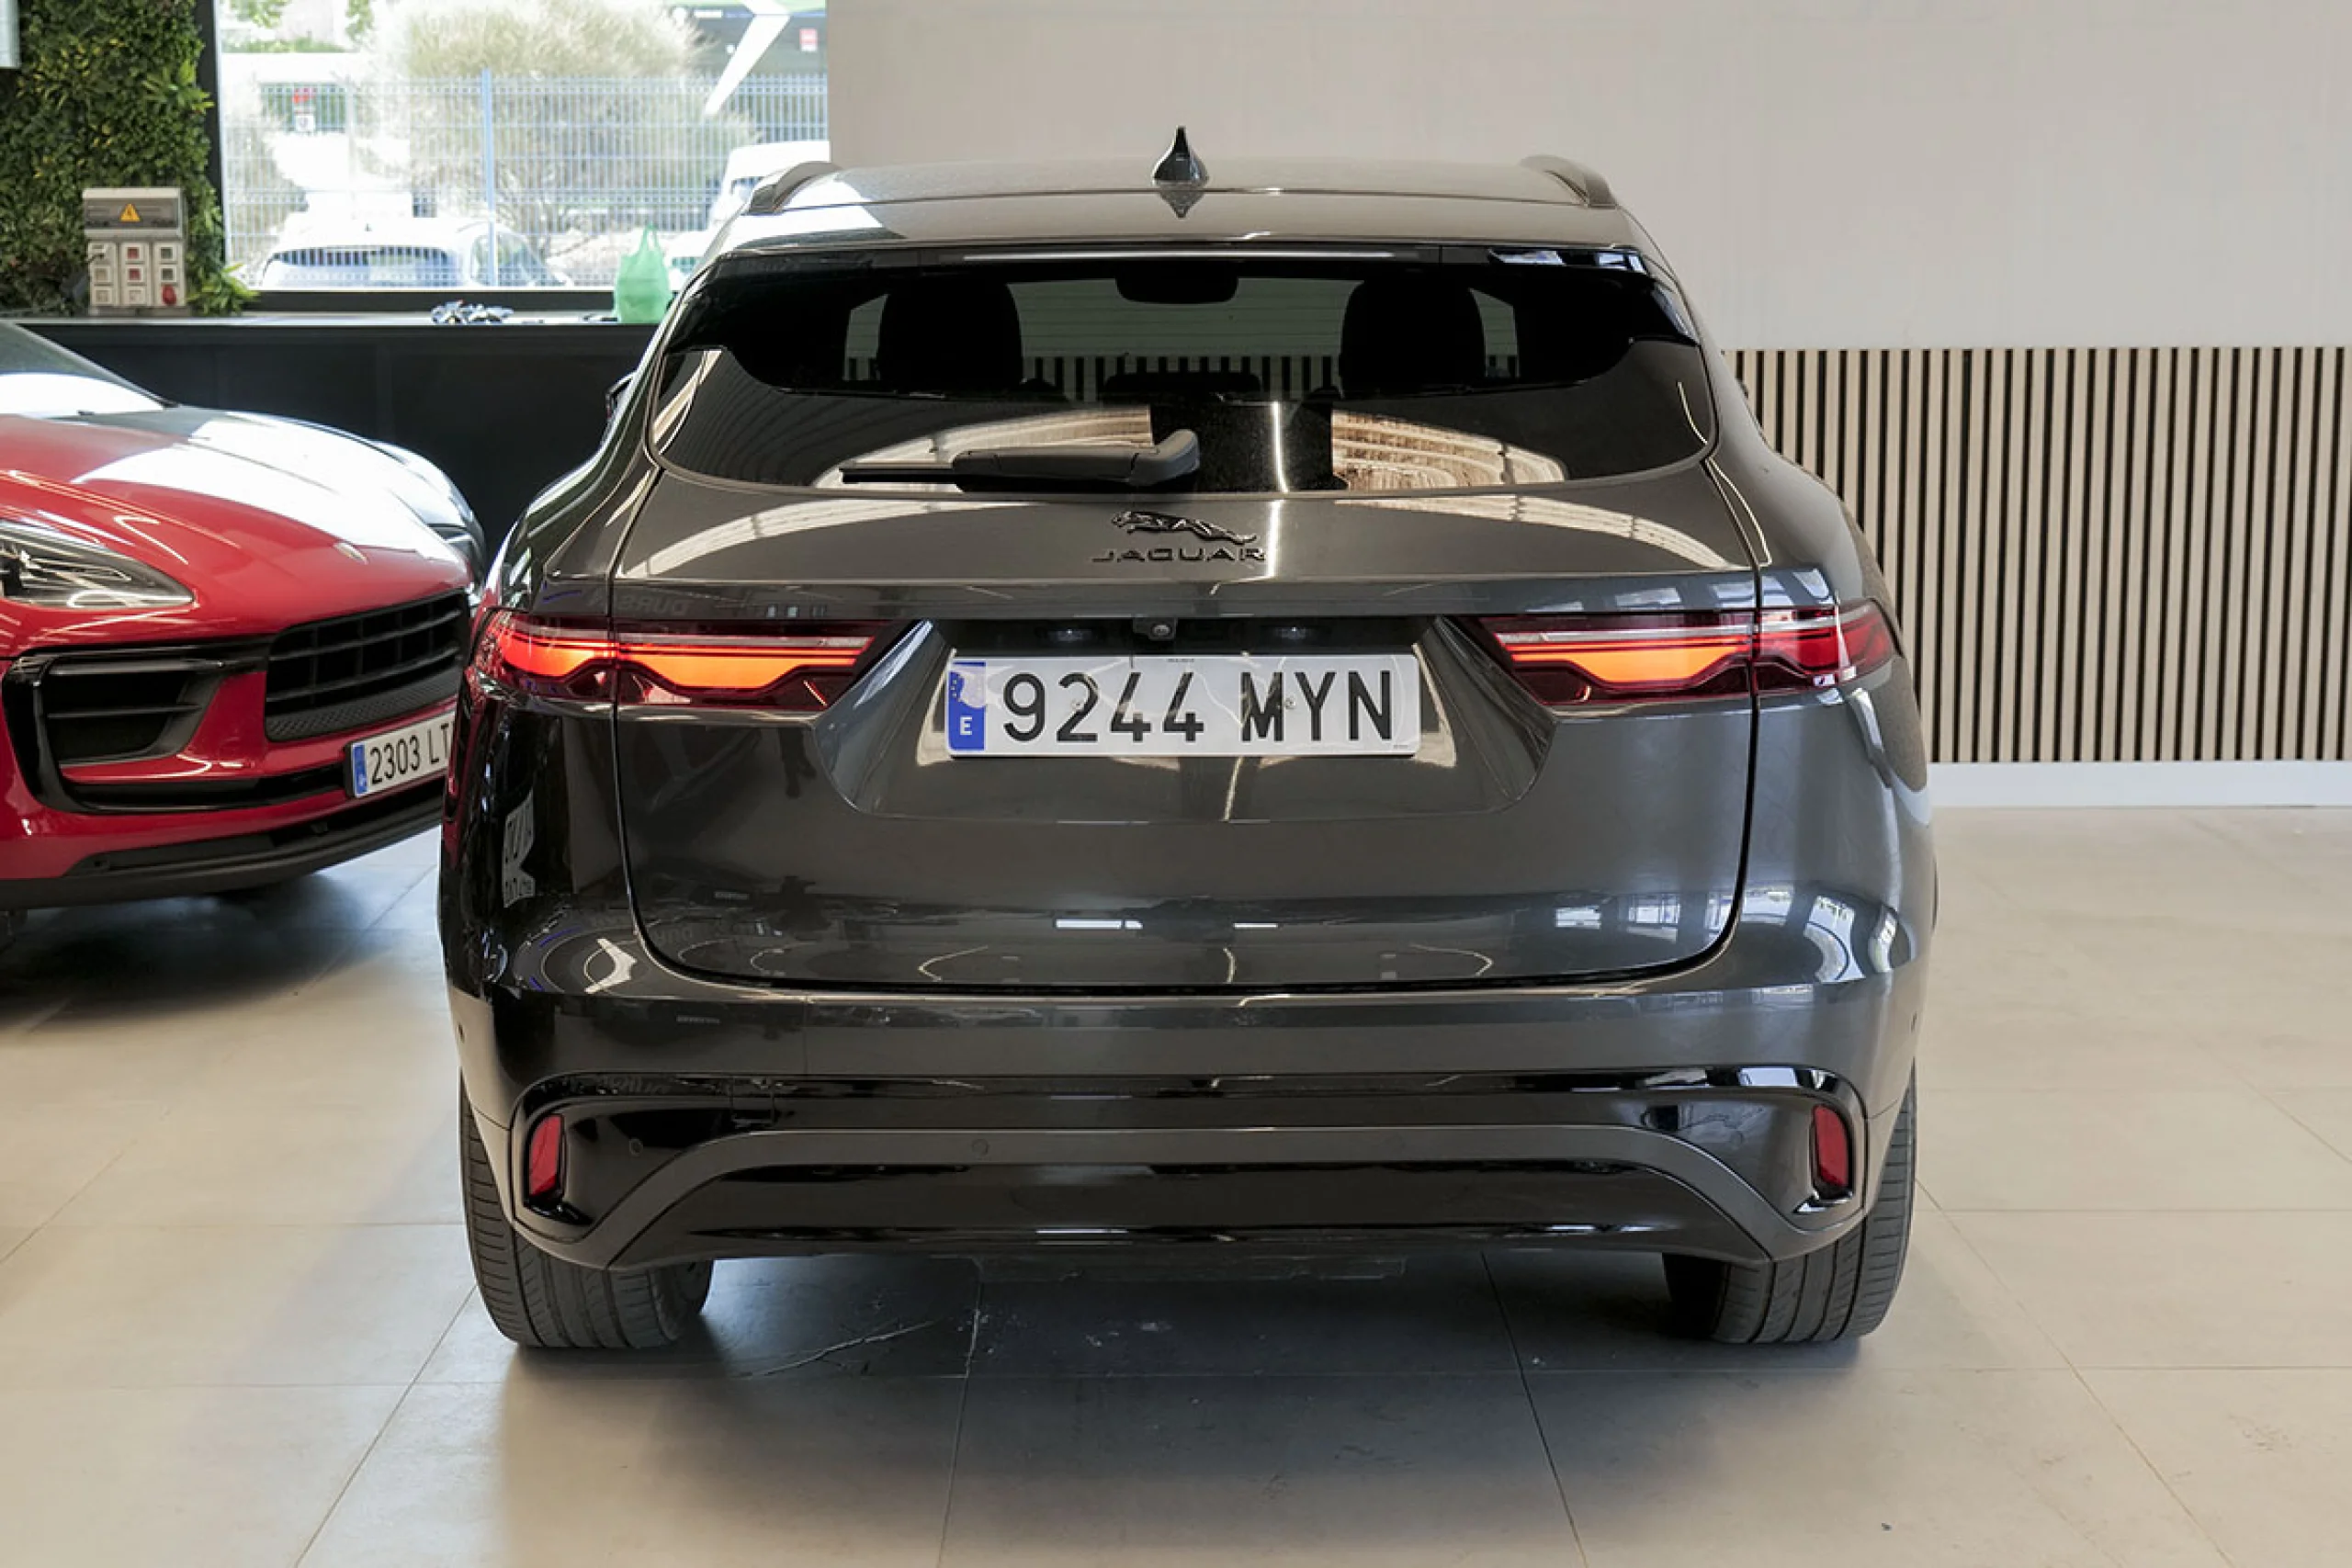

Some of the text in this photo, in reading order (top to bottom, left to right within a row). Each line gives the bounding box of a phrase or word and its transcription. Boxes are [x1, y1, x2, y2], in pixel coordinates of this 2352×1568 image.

[1091, 548, 1266, 563] JAGUAR
[959, 716, 973, 736] E
[1003, 671, 1393, 742] 9244 MYN
[370, 721, 455, 784] 2303 LT
